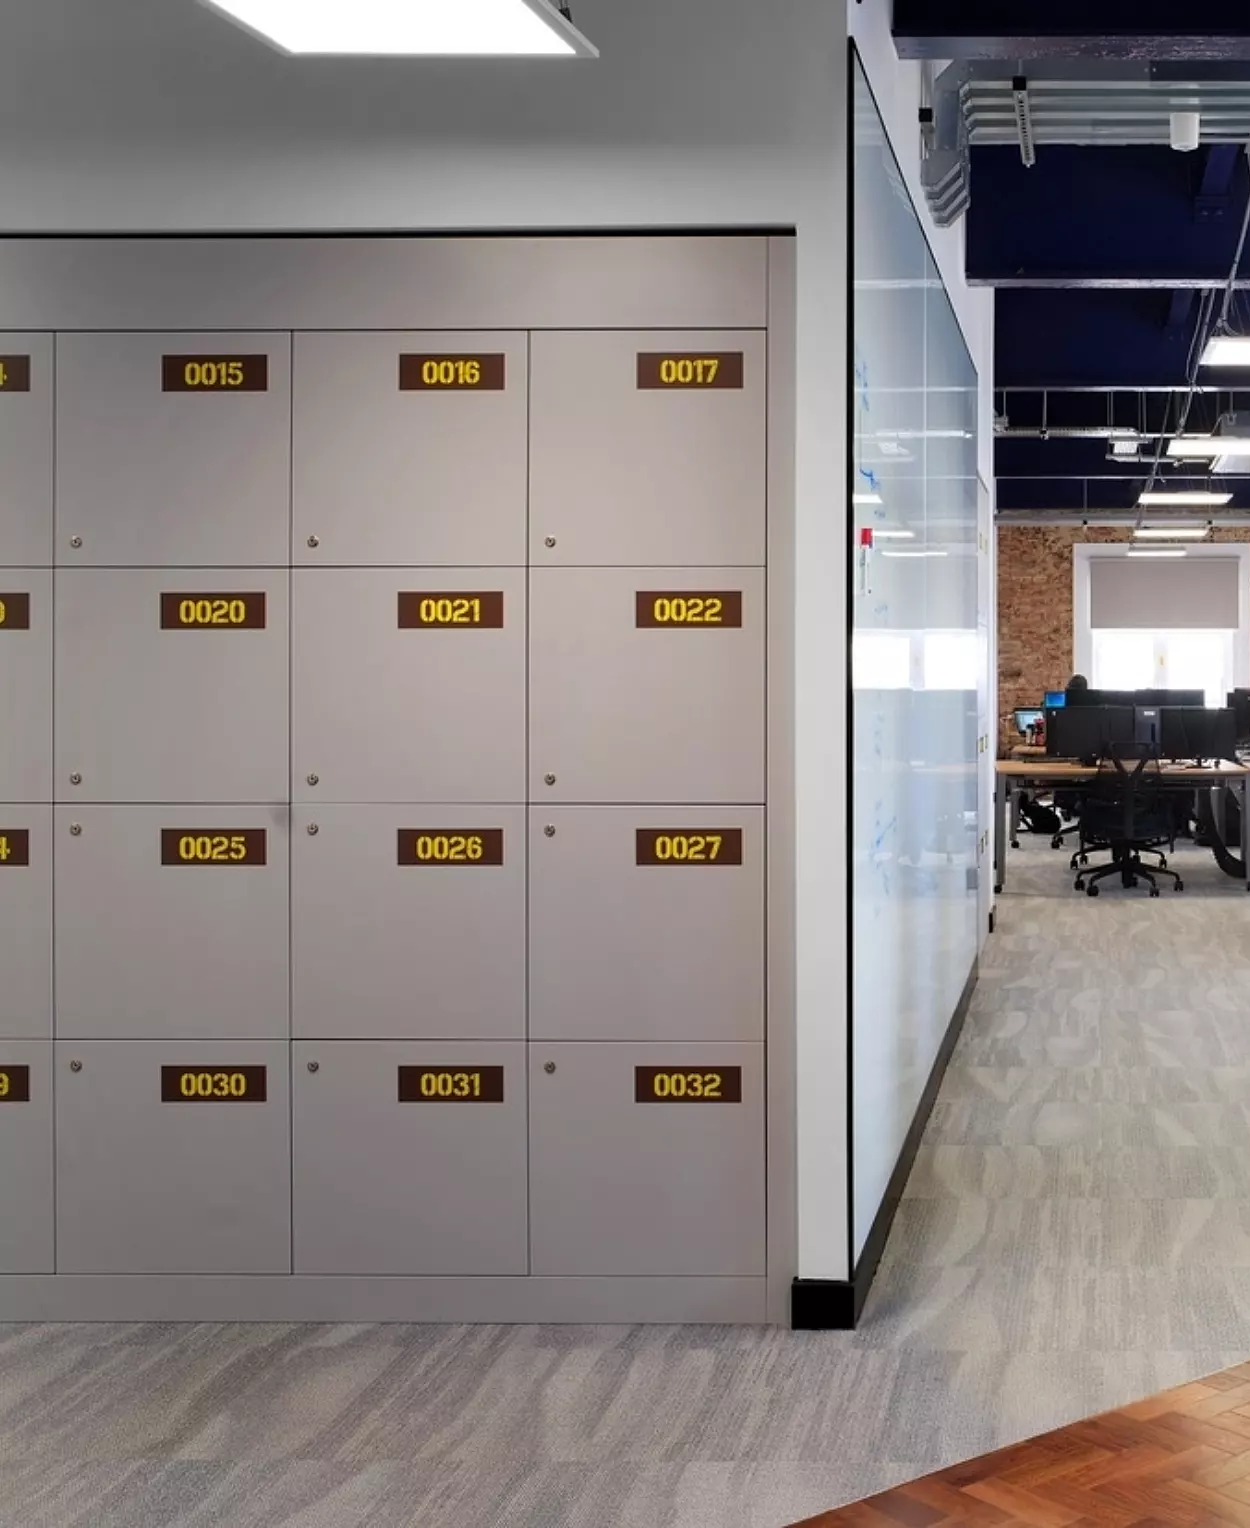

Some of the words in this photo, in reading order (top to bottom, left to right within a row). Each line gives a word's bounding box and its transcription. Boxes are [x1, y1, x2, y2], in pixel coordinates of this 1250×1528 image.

[184, 361, 244, 386] 0015
[421, 359, 481, 385] 0016
[659, 359, 719, 384] 0017
[179, 599, 246, 624] 0020
[419, 598, 481, 624] 0021
[653, 597, 723, 623] 0022
[179, 836, 247, 860] 0025
[416, 835, 483, 860] 0026
[655, 835, 722, 860] 0027
[179, 1073, 246, 1096] 0030
[420, 1073, 482, 1097] 0031
[653, 1073, 722, 1097] 0032
